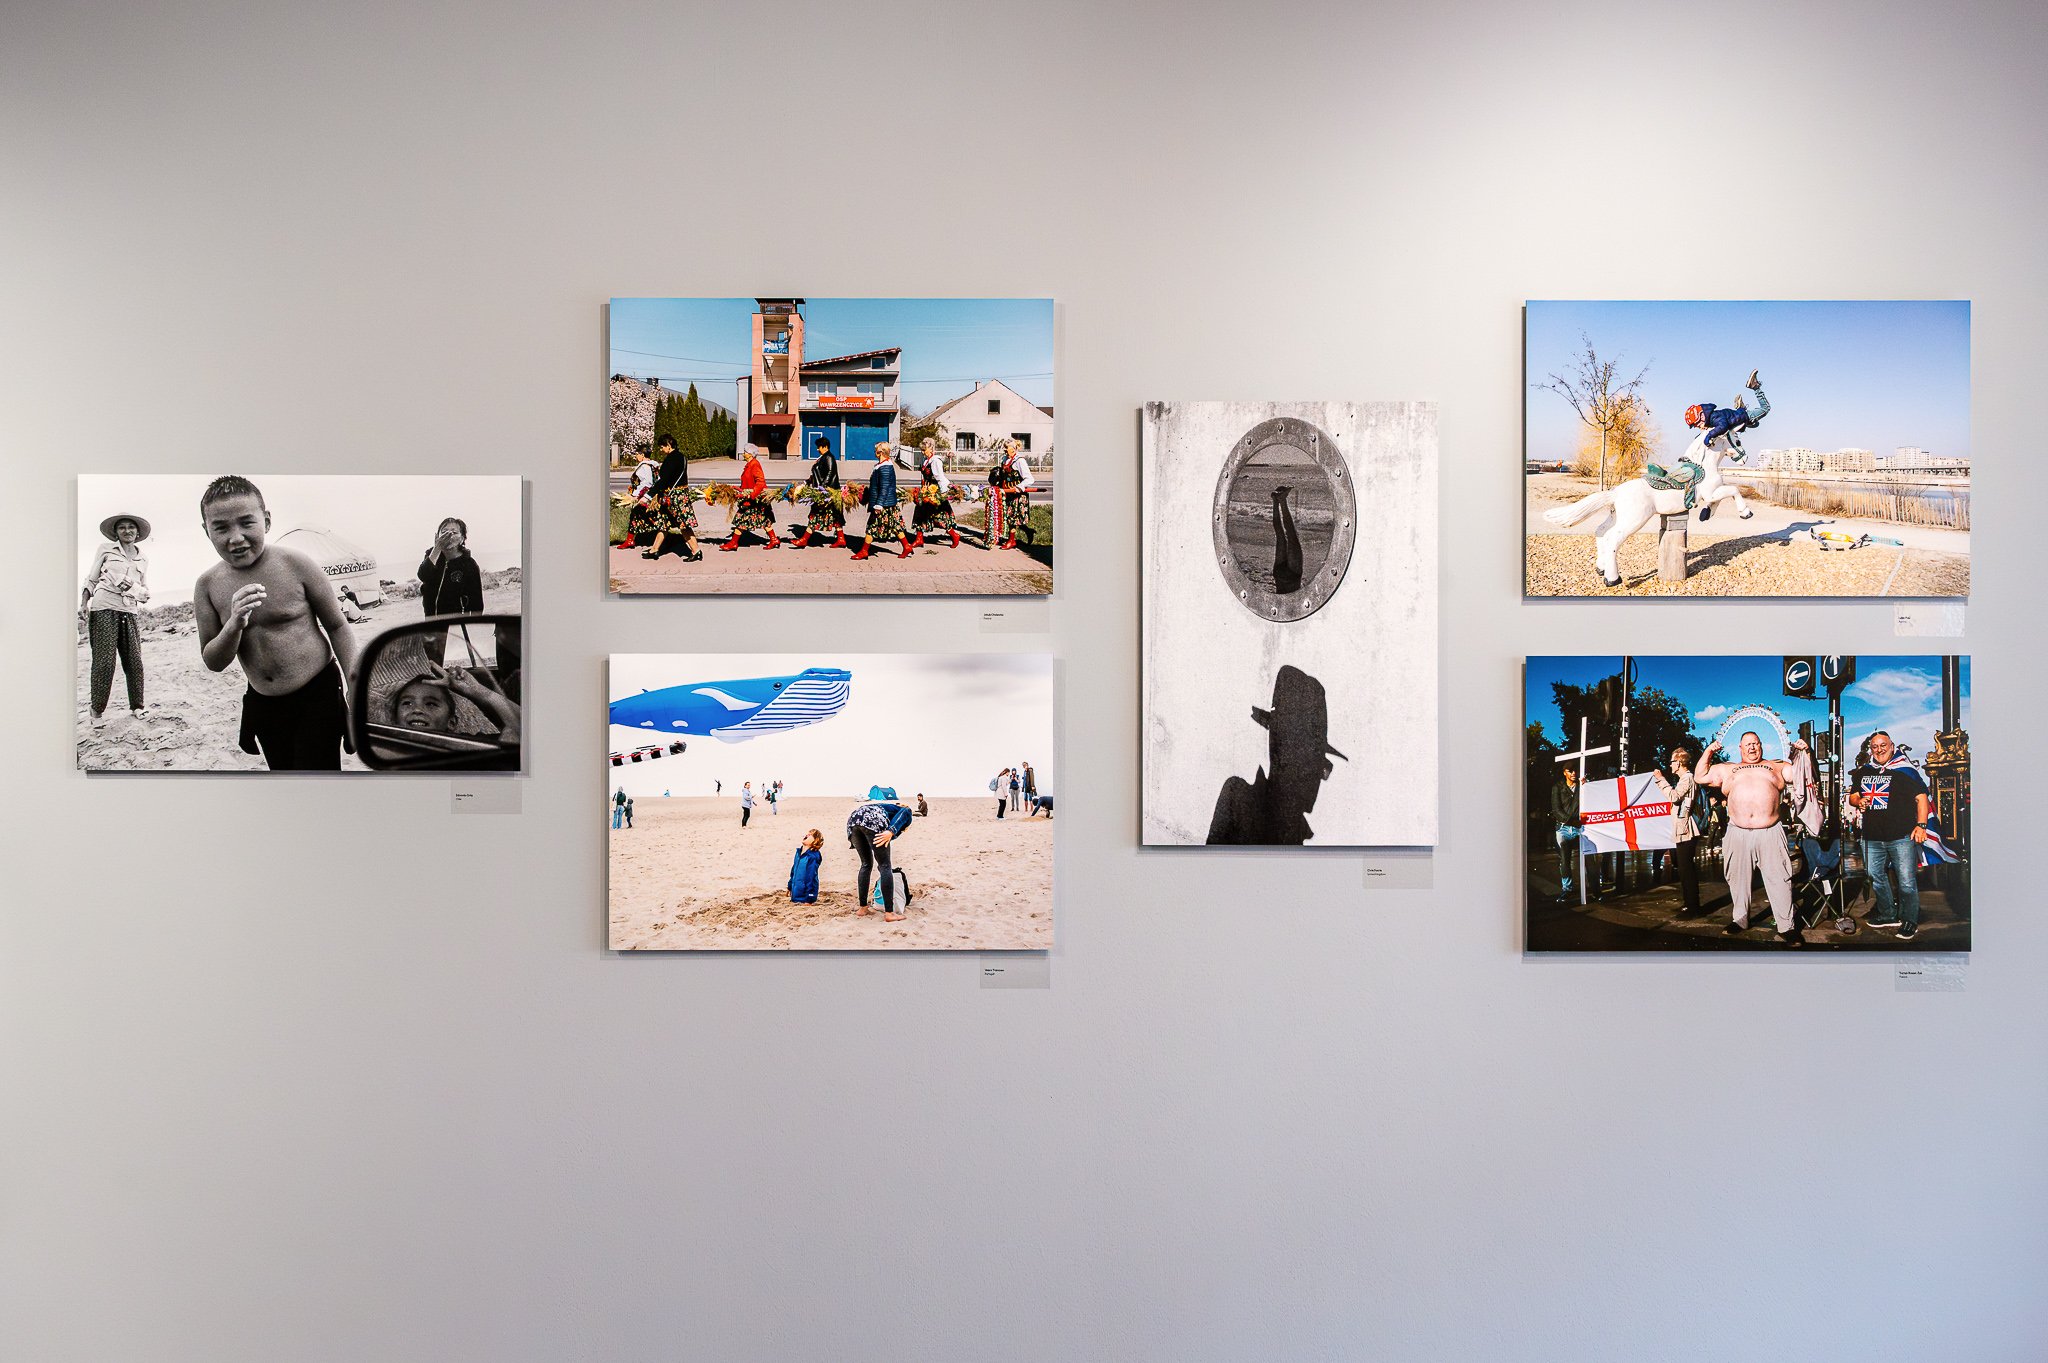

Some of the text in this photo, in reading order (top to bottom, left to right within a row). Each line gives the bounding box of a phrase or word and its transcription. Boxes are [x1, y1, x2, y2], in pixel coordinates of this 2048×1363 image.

[1586, 814, 1614, 822] JESUS
[1626, 808, 1645, 818] THE
[1645, 805, 1667, 815] WAY
